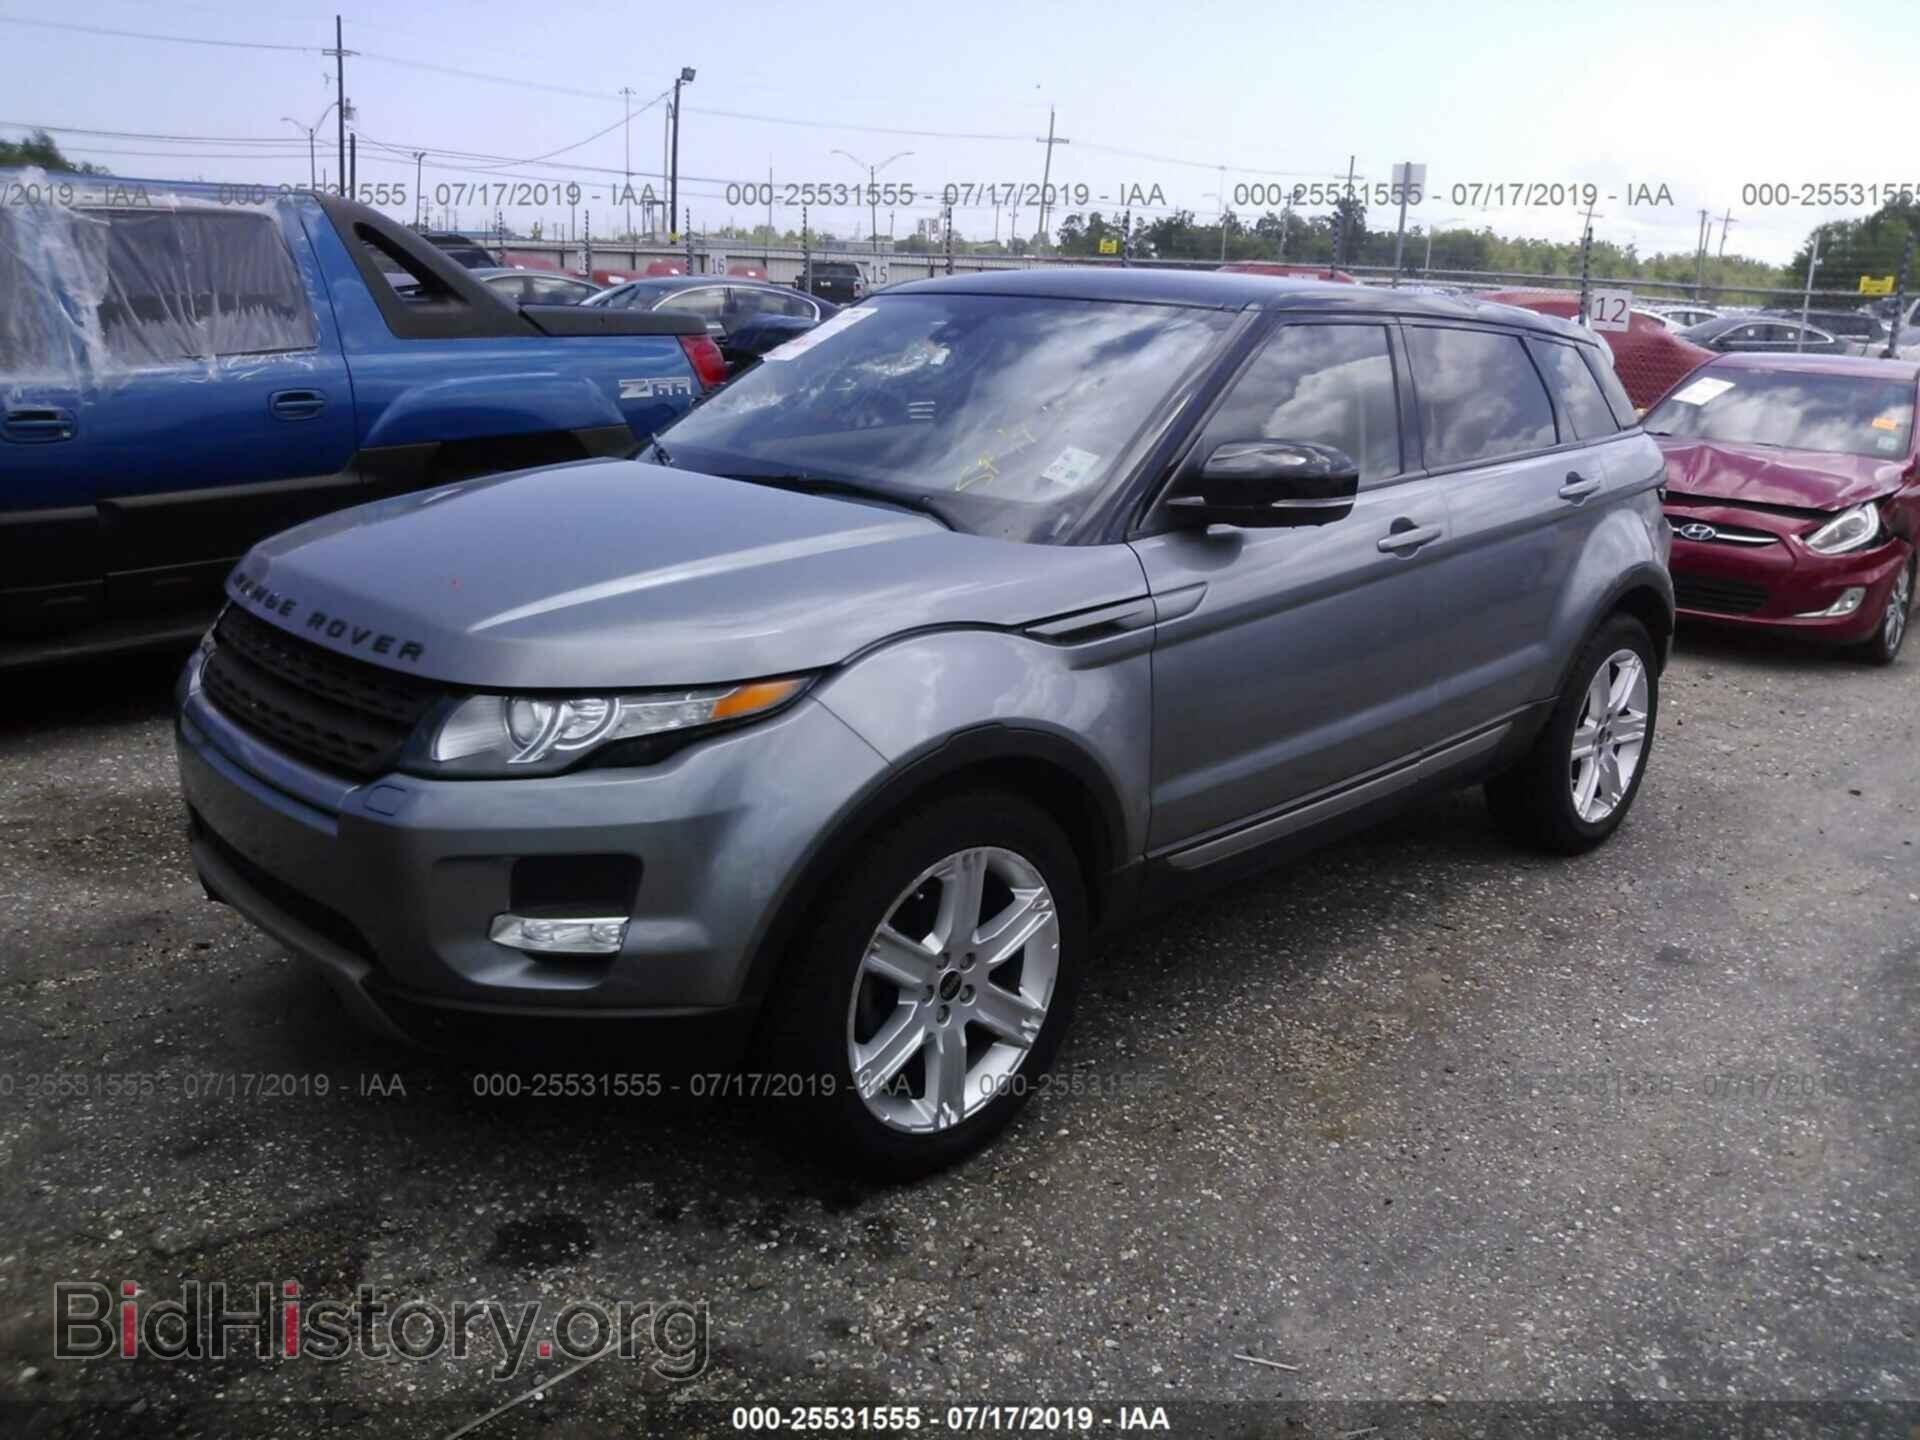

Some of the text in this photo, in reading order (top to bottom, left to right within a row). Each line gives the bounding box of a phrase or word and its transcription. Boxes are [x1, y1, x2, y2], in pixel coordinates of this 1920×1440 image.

[711, 256, 726, 274] 16
[871, 265, 888, 284] 15
[1594, 296, 1627, 324] 12
[306, 611, 425, 662] ROVER
